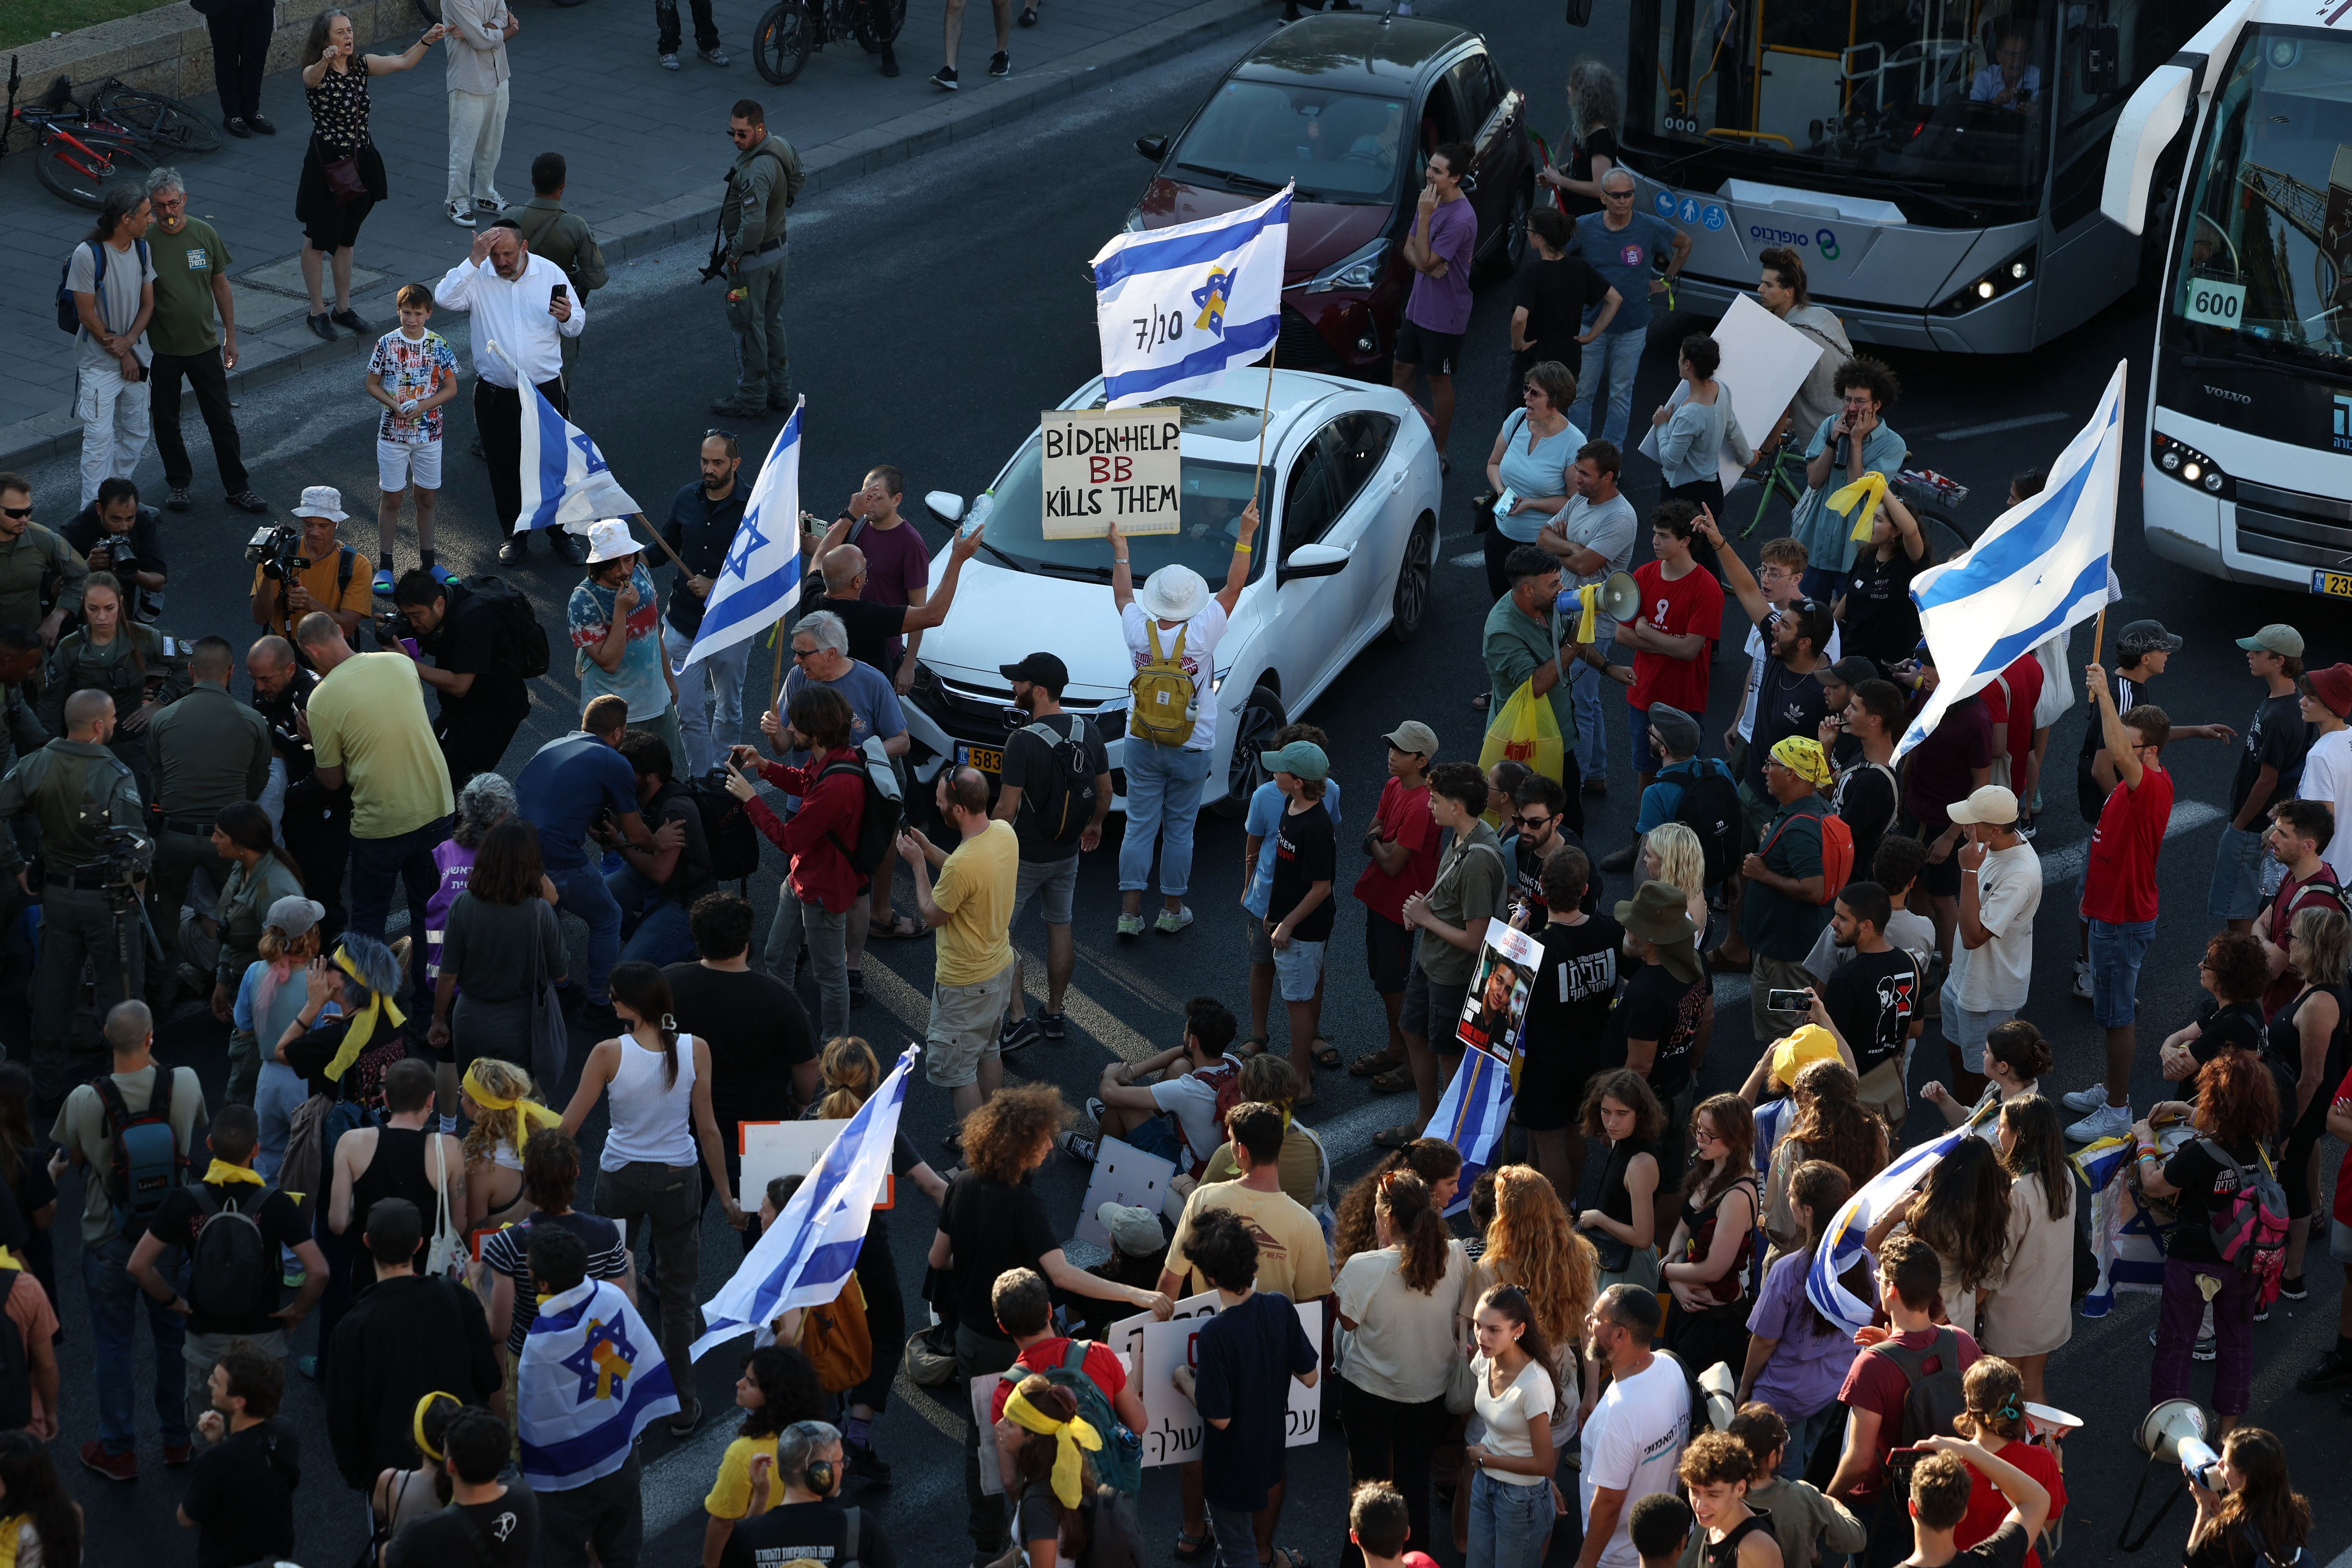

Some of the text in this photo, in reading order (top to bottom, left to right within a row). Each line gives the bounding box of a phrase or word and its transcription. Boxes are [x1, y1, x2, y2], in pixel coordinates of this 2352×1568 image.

[1665, 117, 1696, 133] 000
[1751, 226, 1809, 246] סופרבוס
[2196, 291, 2238, 318] 600
[1133, 304, 1183, 354] 7/10
[2203, 385, 2252, 405] VOLVO
[1089, 456, 1133, 483] BB
[1111, 485, 1178, 514] THEM
[627, 604, 646, 617] LEGEND
[1784, 711, 1799, 725] adidas
[960, 752, 967, 761] IL
[974, 749, 1002, 770] 583
[1714, 825, 1729, 836] mobileye
[1509, 941, 1528, 956] ALEXANDER
[1570, 958, 1608, 990] הבית
[1467, 996, 1482, 1014] BRING
[1463, 1007, 1475, 1023] HIM
[1459, 1020, 1490, 1046] HOME NOW!
[783, 1546, 817, 1560] המשפחות
[817, 1545, 835, 1559] מטה
